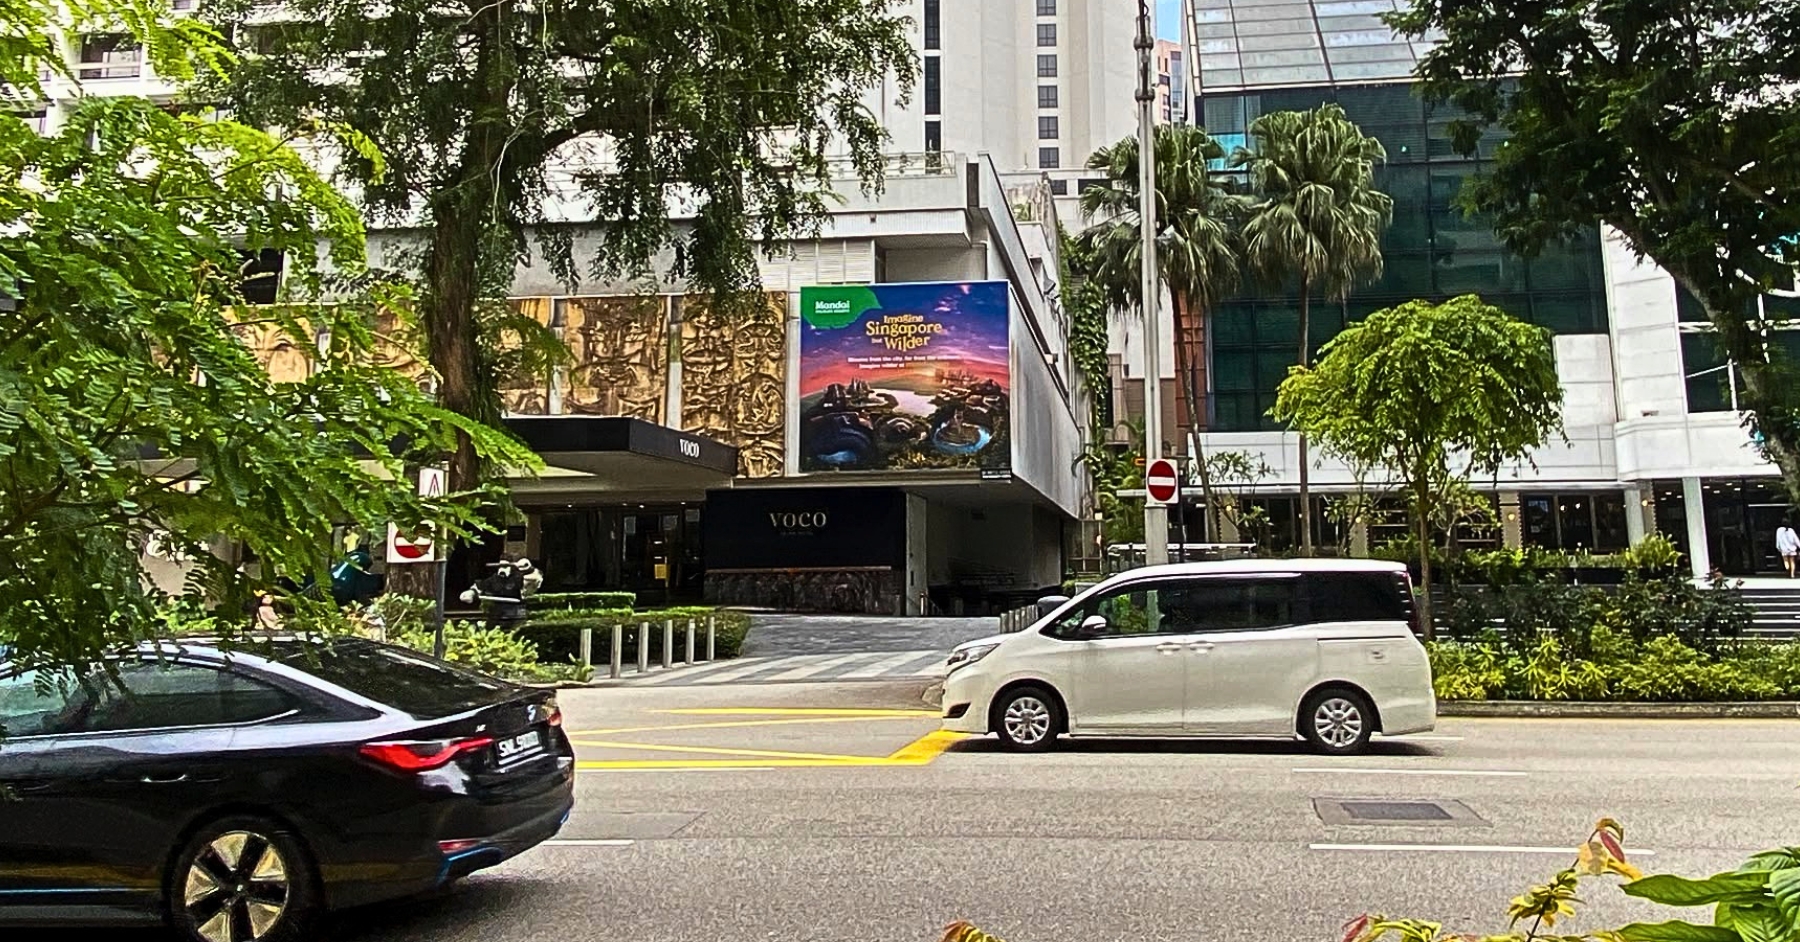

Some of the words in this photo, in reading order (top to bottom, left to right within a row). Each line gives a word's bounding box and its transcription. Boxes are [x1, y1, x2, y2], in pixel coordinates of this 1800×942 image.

[814, 299, 851, 310] Mandai
[883, 314, 924, 324] Imagine
[865, 320, 943, 338] Singapore
[884, 335, 931, 352] Wilder
